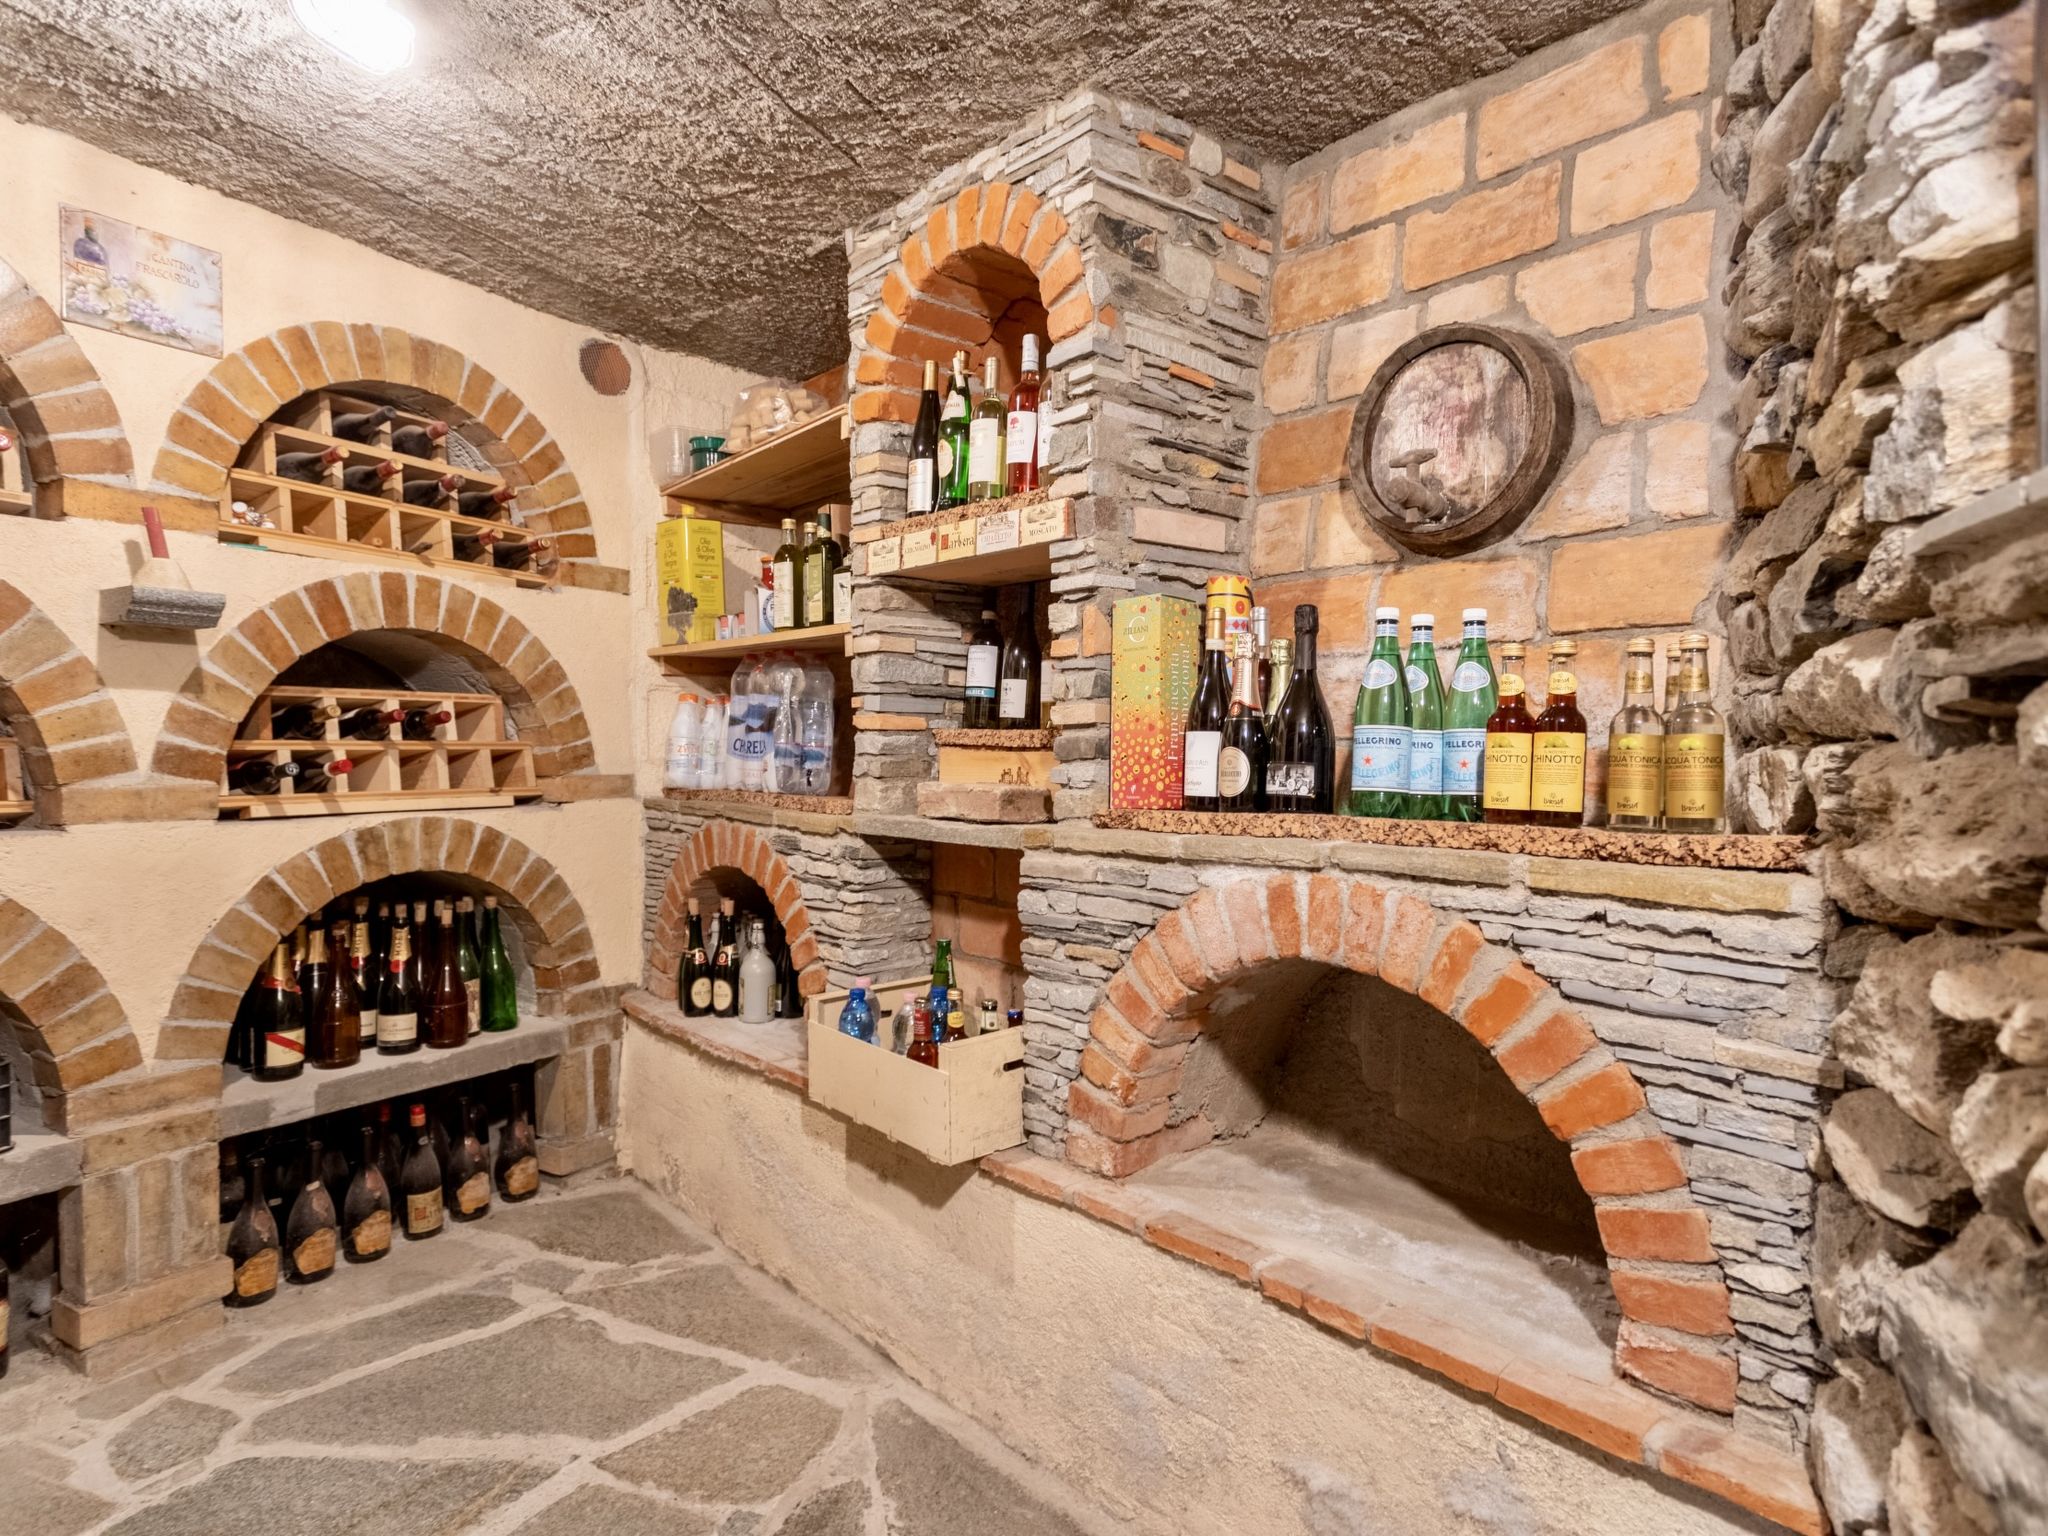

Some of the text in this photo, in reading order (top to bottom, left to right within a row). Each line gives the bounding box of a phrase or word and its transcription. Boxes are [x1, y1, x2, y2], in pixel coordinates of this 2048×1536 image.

[151, 253, 197, 274] CANTINA
[1029, 525, 1057, 536] MOSCATO
[1166, 653, 1179, 761] Franciacorta
[1486, 754, 1528, 764] HINOTTO
[1608, 755, 1660, 764] CQUA TONICA
